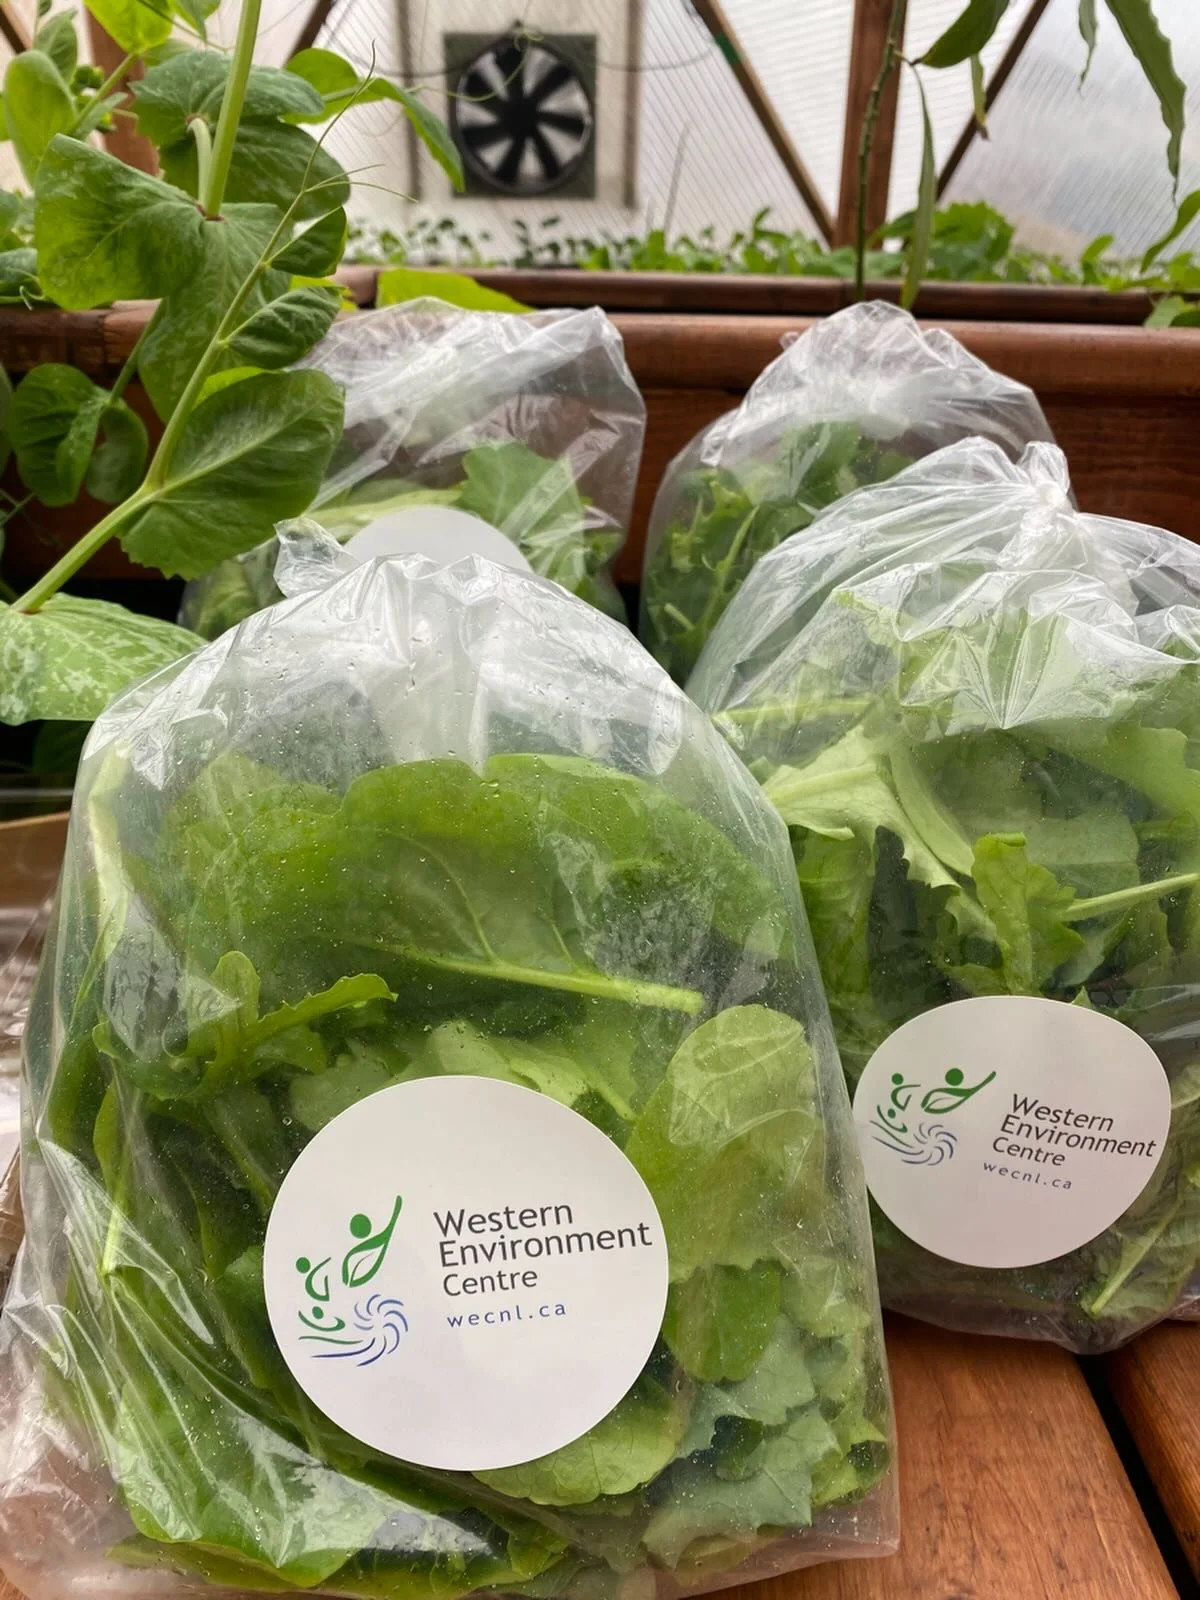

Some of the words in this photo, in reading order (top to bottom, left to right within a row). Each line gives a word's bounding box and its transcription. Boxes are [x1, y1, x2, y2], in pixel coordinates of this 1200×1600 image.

[1012, 1093, 1115, 1133] Western
[992, 1136, 1066, 1167] Centre
[1000, 1114, 1157, 1158] Environment
[982, 1161, 1073, 1190] wecnl.ca
[433, 1203, 574, 1238] Western
[438, 1221, 653, 1269] Environment
[442, 1269, 539, 1297] Centre
[446, 1301, 567, 1328] wecnl.ca
